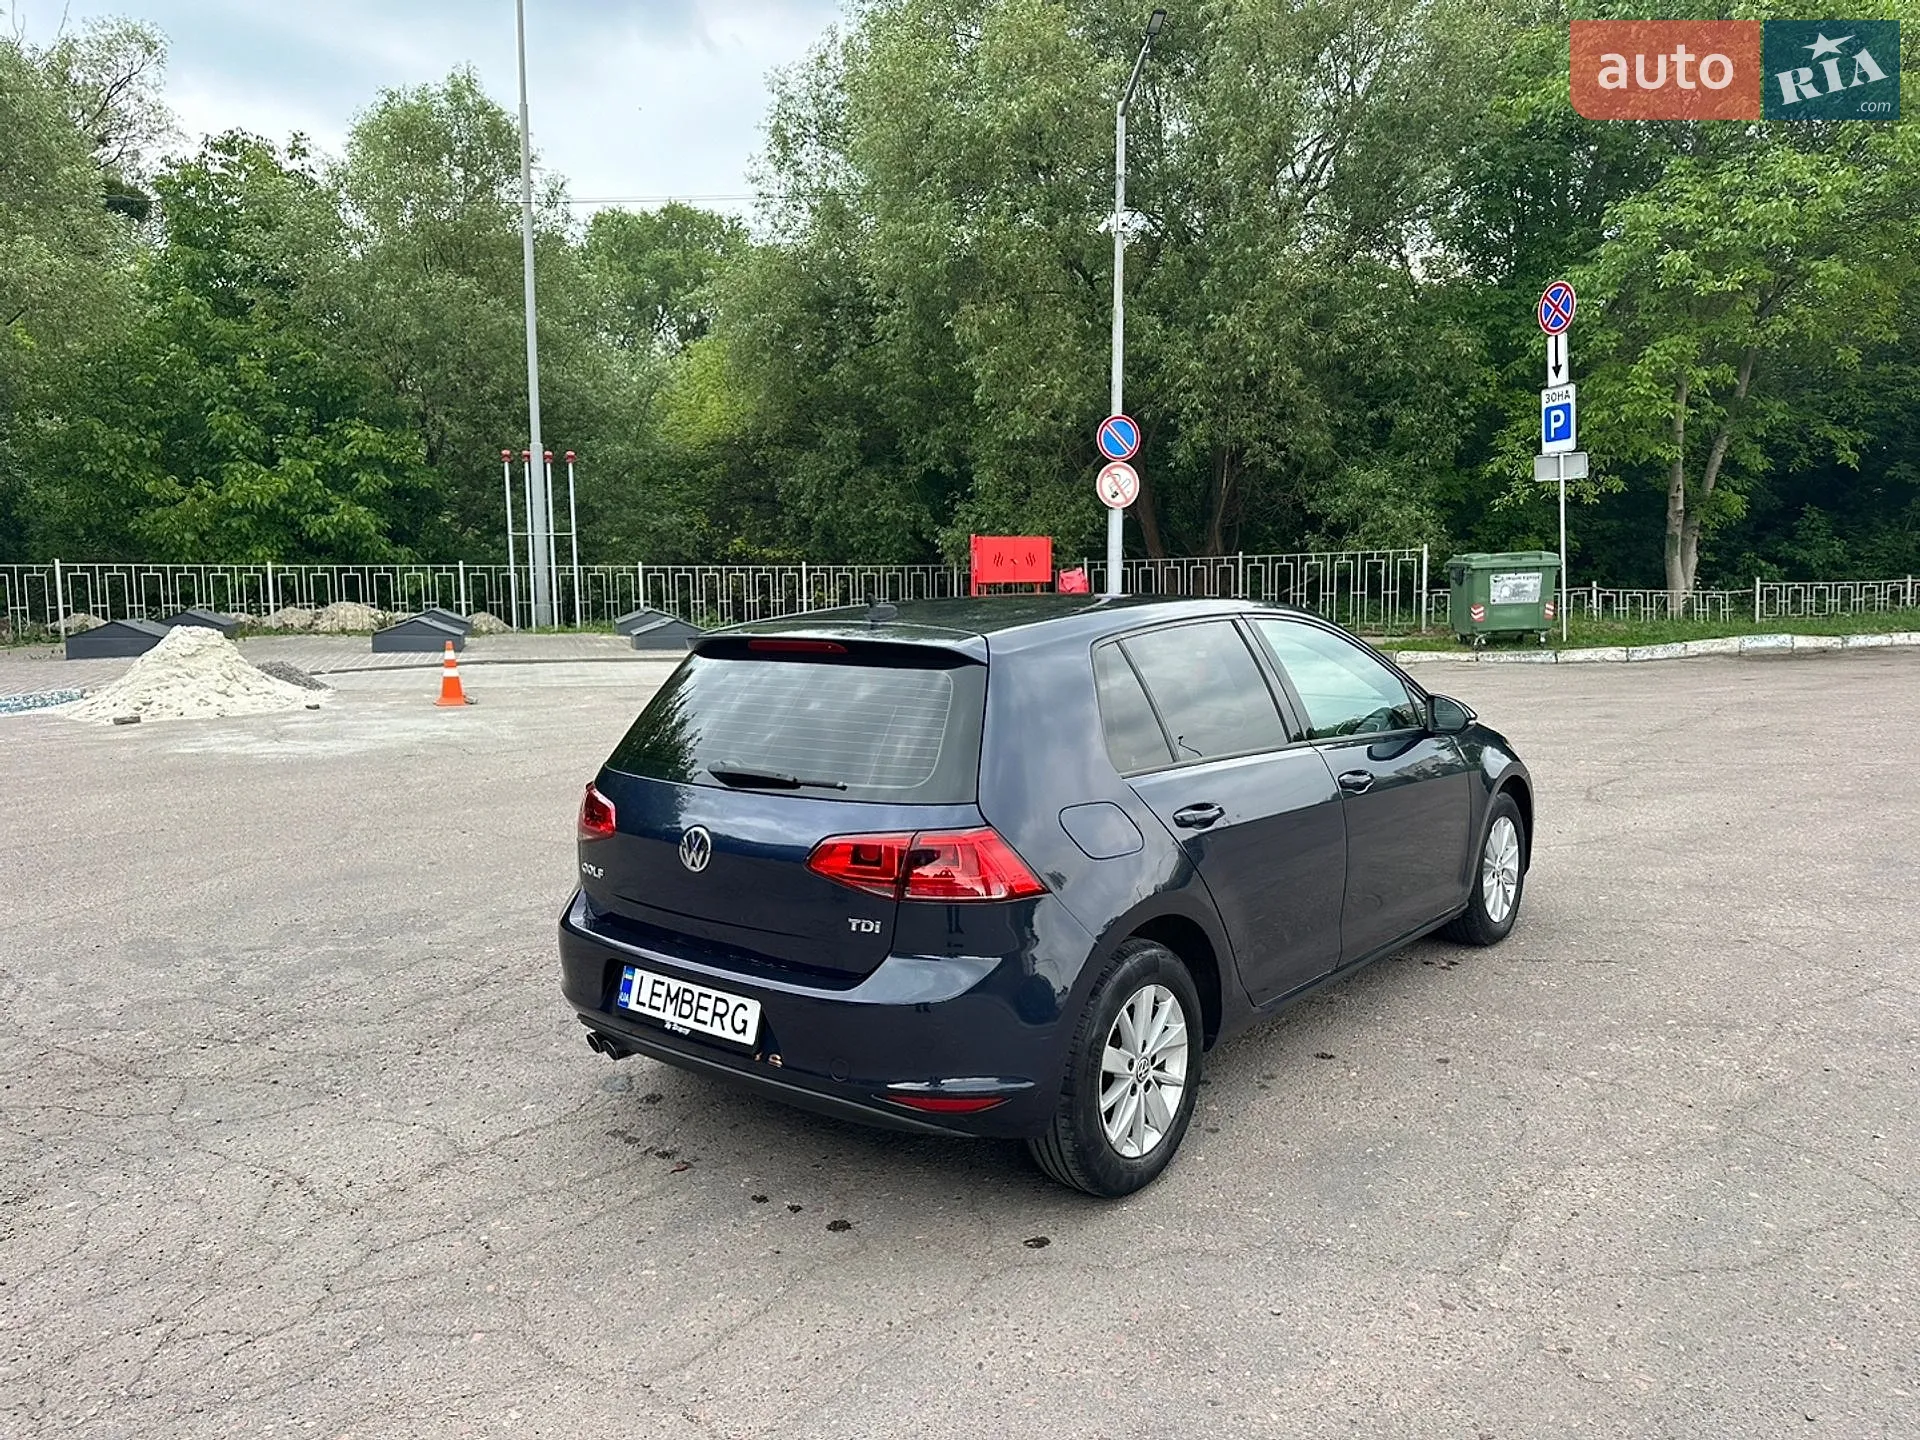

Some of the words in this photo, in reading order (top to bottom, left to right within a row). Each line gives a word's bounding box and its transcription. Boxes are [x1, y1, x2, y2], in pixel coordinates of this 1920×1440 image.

[1545, 389, 1571, 404] ЗОНА
[1551, 409, 1566, 439] P
[635, 975, 749, 1037] LEMBERG
